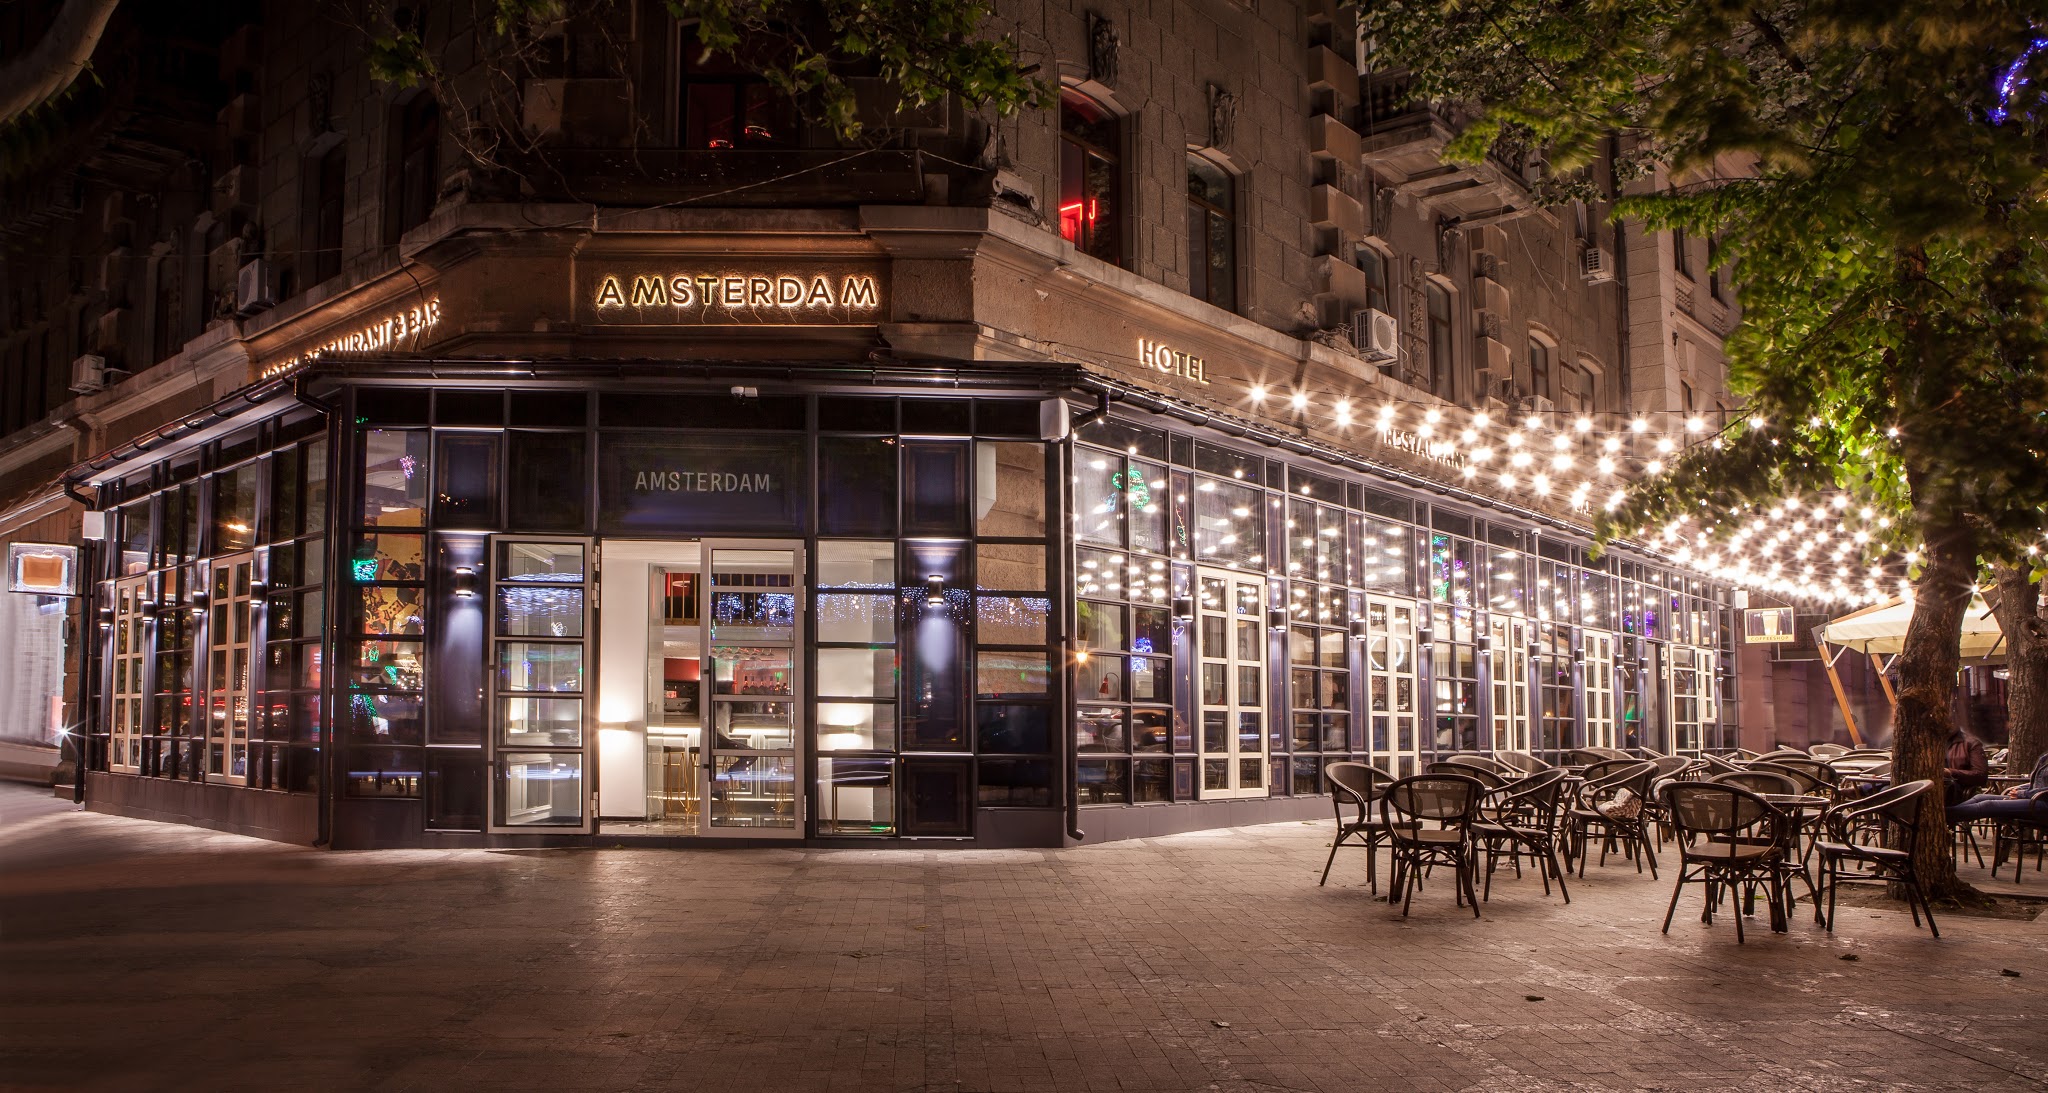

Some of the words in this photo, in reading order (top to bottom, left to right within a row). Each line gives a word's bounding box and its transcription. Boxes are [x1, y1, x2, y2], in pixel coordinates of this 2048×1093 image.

[597, 276, 877, 307] AMSTERDAM
[394, 312, 406, 339] &
[409, 299, 439, 334] BAR
[1138, 339, 1211, 385] HOTEL
[1383, 428, 1468, 471] RESTAUNT
[634, 471, 771, 493] AMSTERDAM
